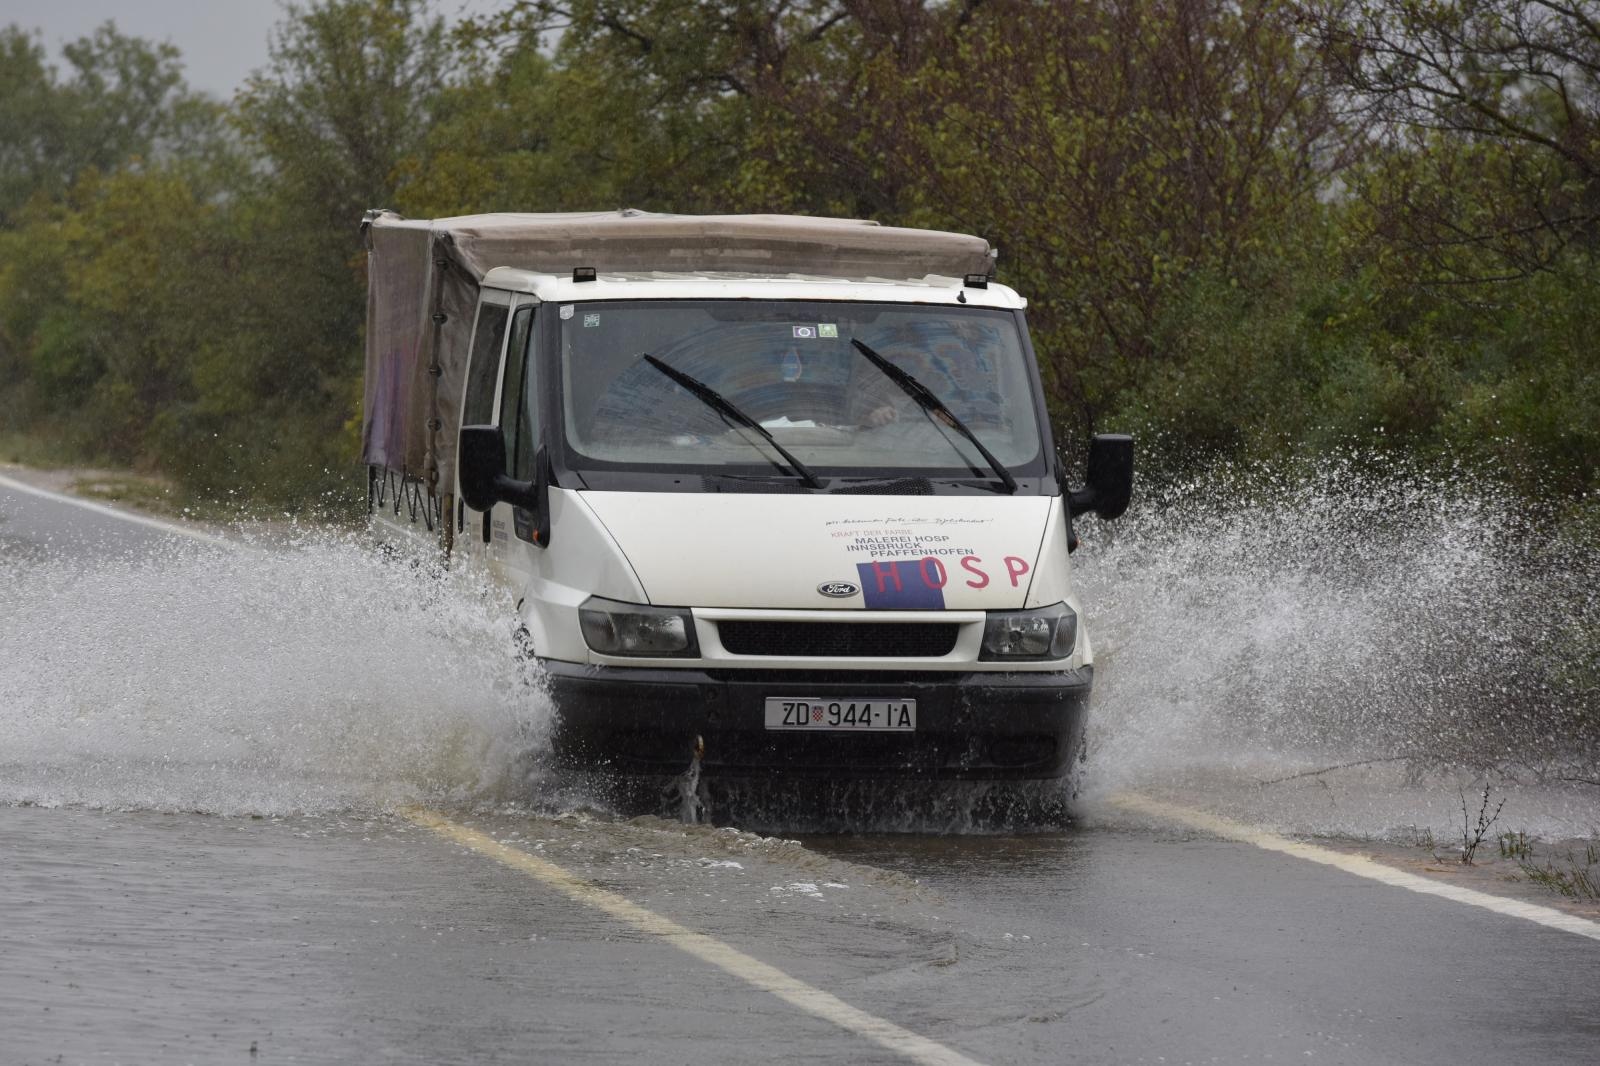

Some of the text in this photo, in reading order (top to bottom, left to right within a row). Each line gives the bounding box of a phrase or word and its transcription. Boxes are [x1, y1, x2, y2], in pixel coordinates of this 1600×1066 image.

[831, 530, 860, 538] KRAFT
[855, 535, 950, 545] MALEREI HOSP
[846, 542, 922, 552] INNSBRUCK
[870, 548, 975, 558] PFAFFENHOFEN
[872, 555, 1030, 593] HOSP
[827, 583, 851, 593] Ford
[782, 702, 809, 726] ZD
